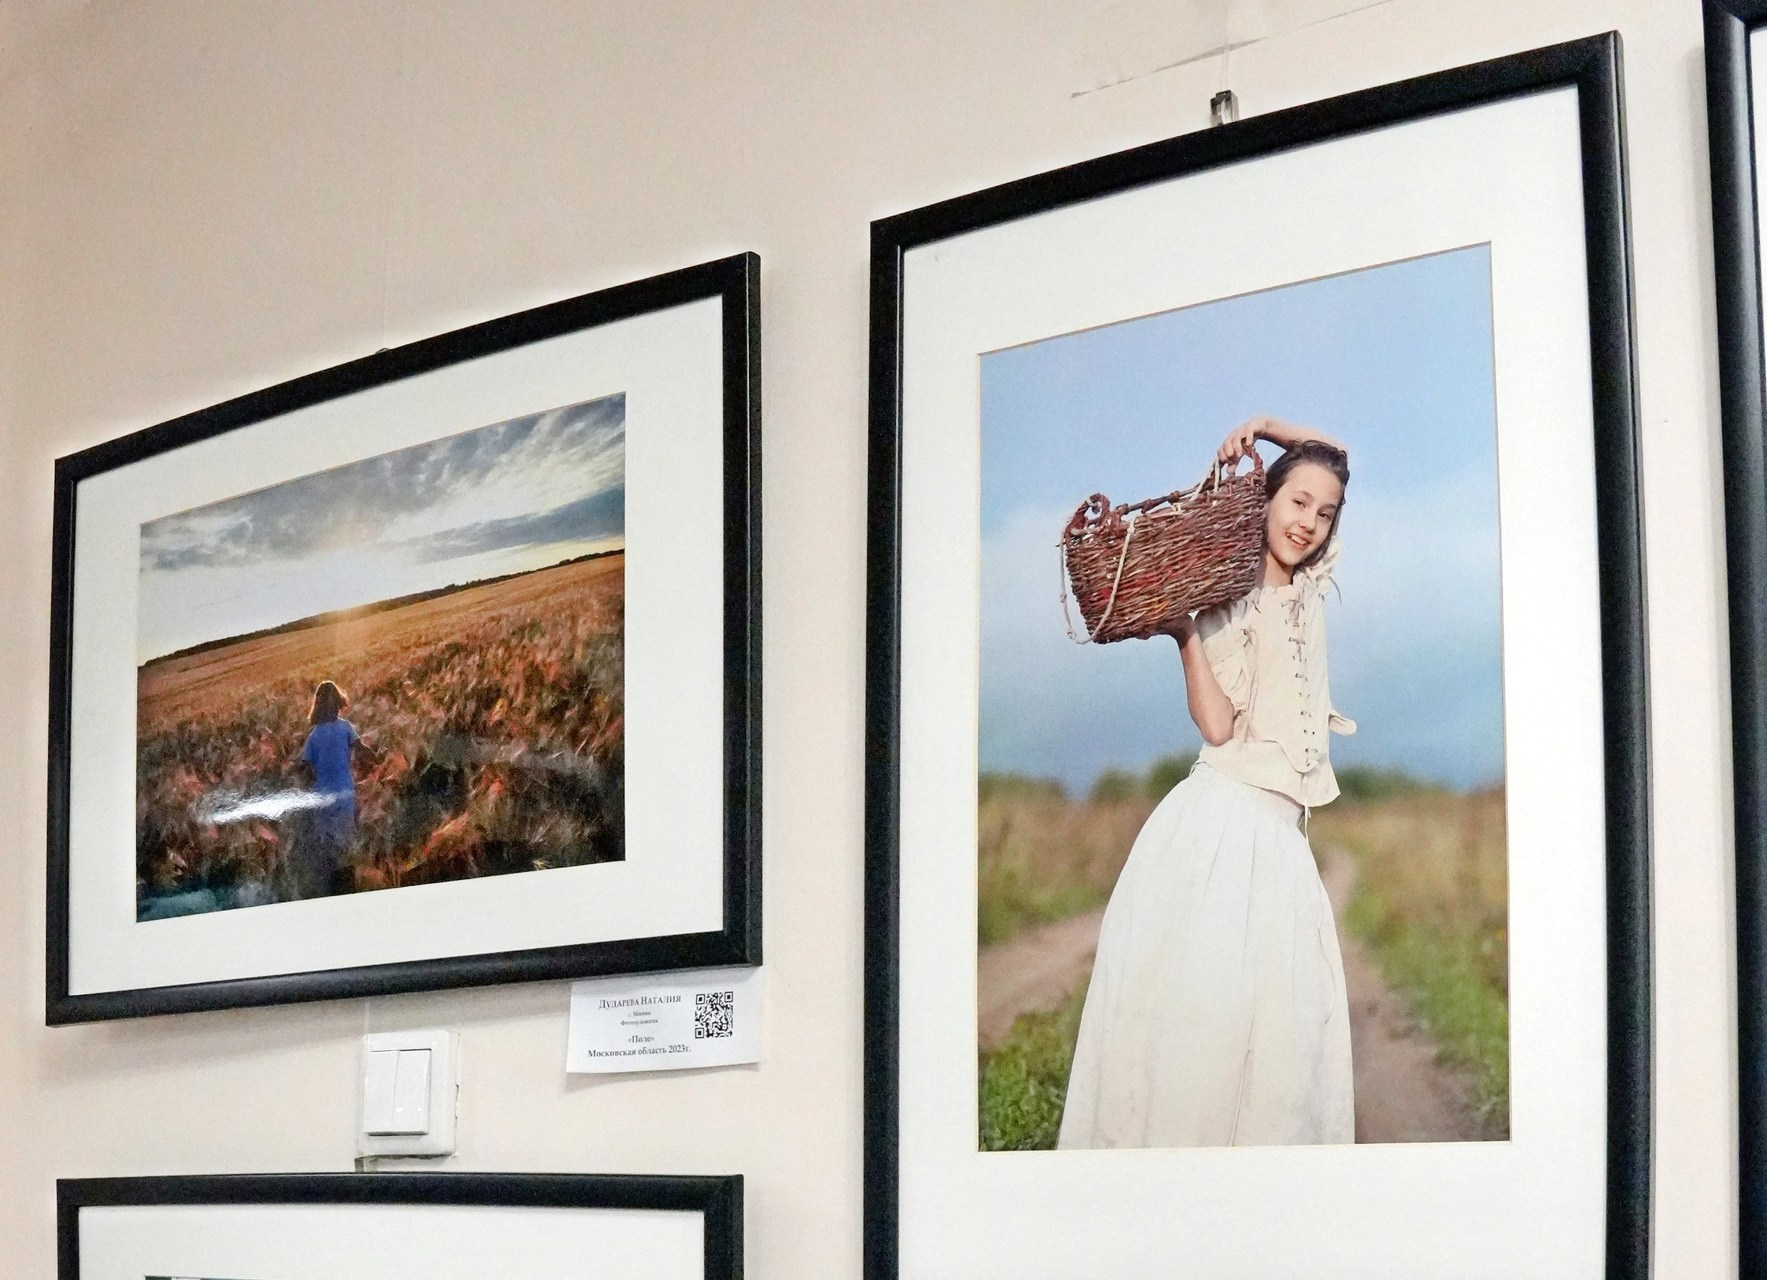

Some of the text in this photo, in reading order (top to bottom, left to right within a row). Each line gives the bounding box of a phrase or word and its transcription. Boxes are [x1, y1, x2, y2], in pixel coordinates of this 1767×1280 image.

[640, 995, 682, 1005] НАТАЛИЯ
[587, 1044, 692, 1058] Московская область 2023г.
